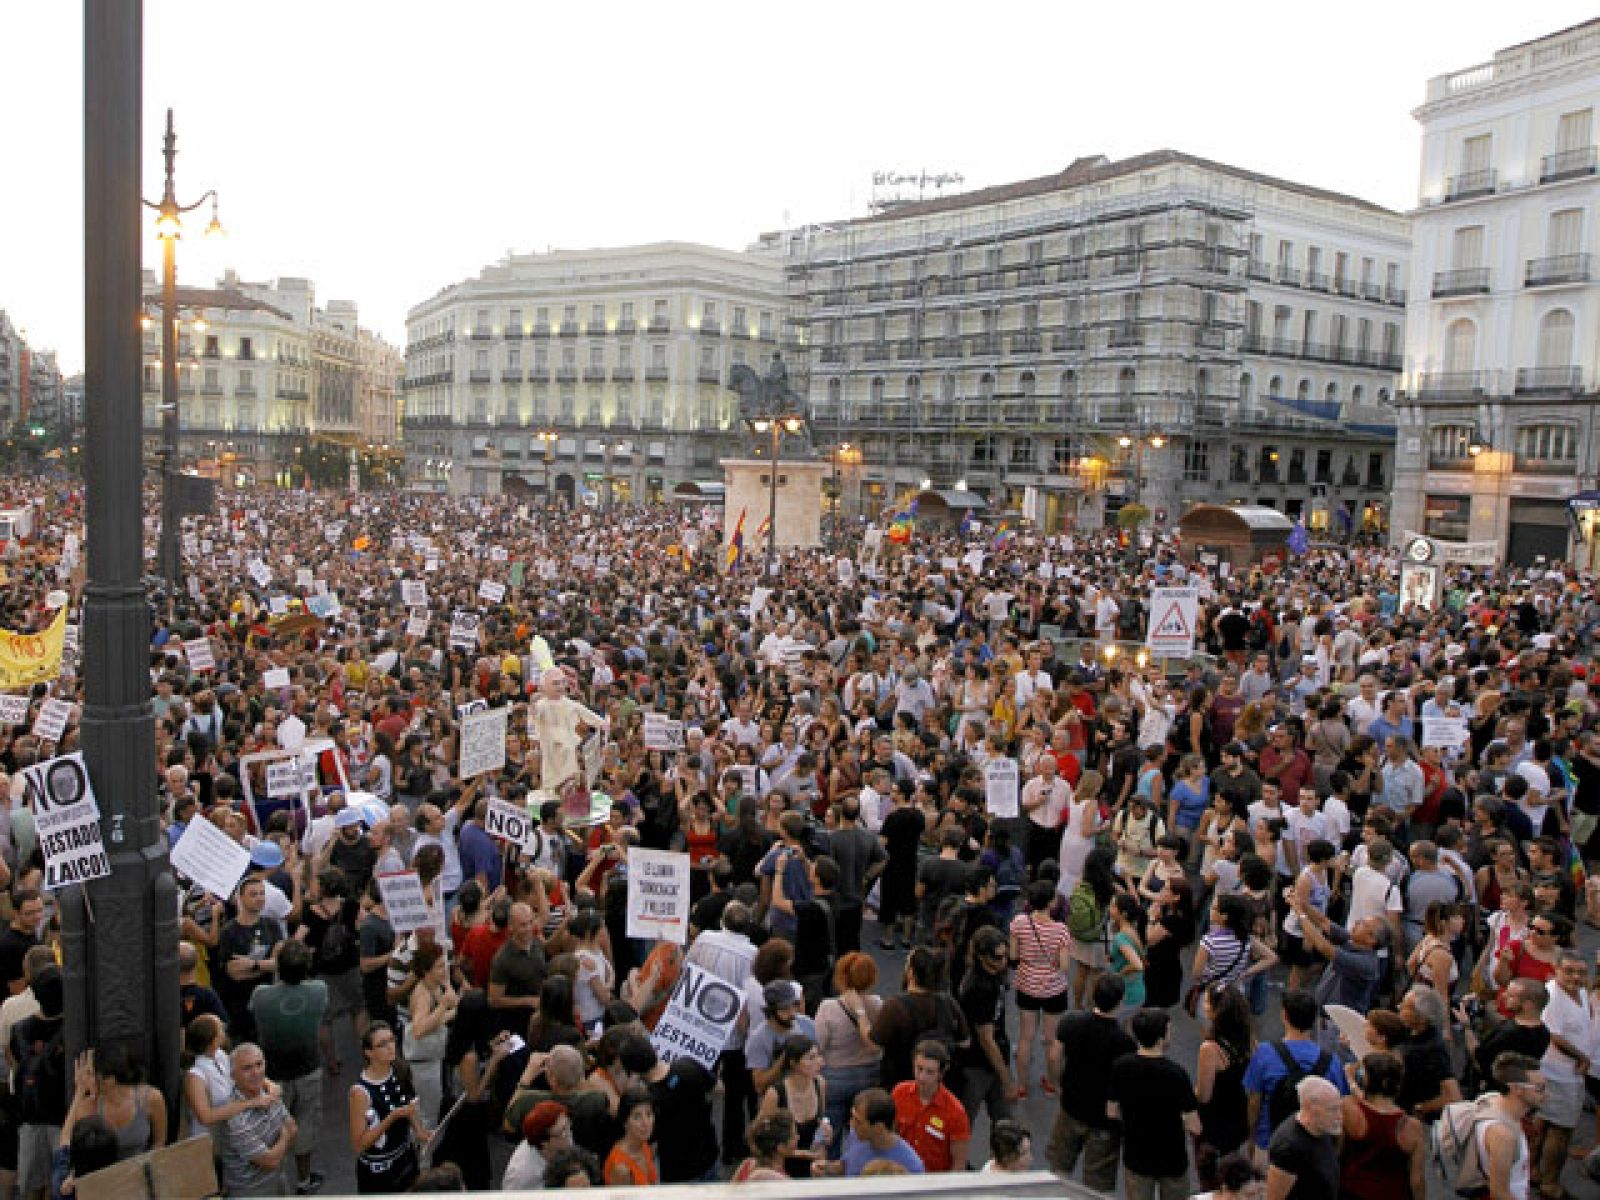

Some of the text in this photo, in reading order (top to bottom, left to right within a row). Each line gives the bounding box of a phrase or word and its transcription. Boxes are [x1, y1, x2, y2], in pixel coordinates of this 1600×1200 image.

[23, 759, 86, 815] NO
[489, 809, 530, 844] NO!
[671, 966, 741, 1023] NO
